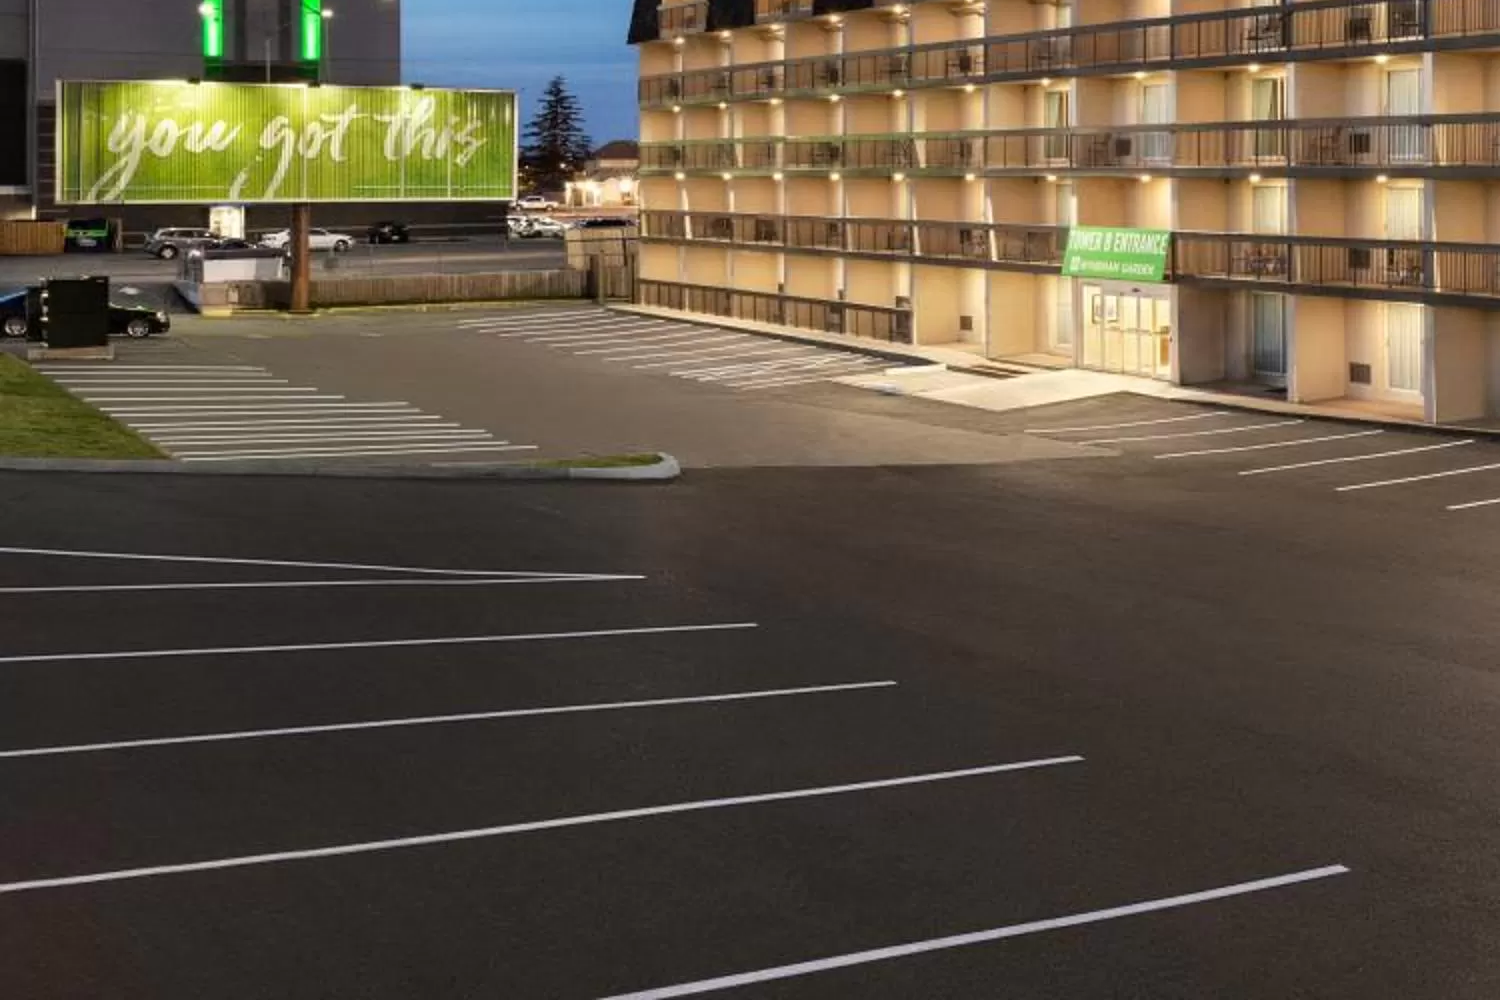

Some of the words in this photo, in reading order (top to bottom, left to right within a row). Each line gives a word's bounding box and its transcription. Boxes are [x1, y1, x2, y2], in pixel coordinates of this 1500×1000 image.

[87, 108, 242, 200] you
[229, 104, 370, 200] got
[373, 90, 487, 168] this
[1069, 230, 1102, 251] TOWER
[1103, 232, 1113, 252] B
[1113, 232, 1169, 255] ENTRANCE
